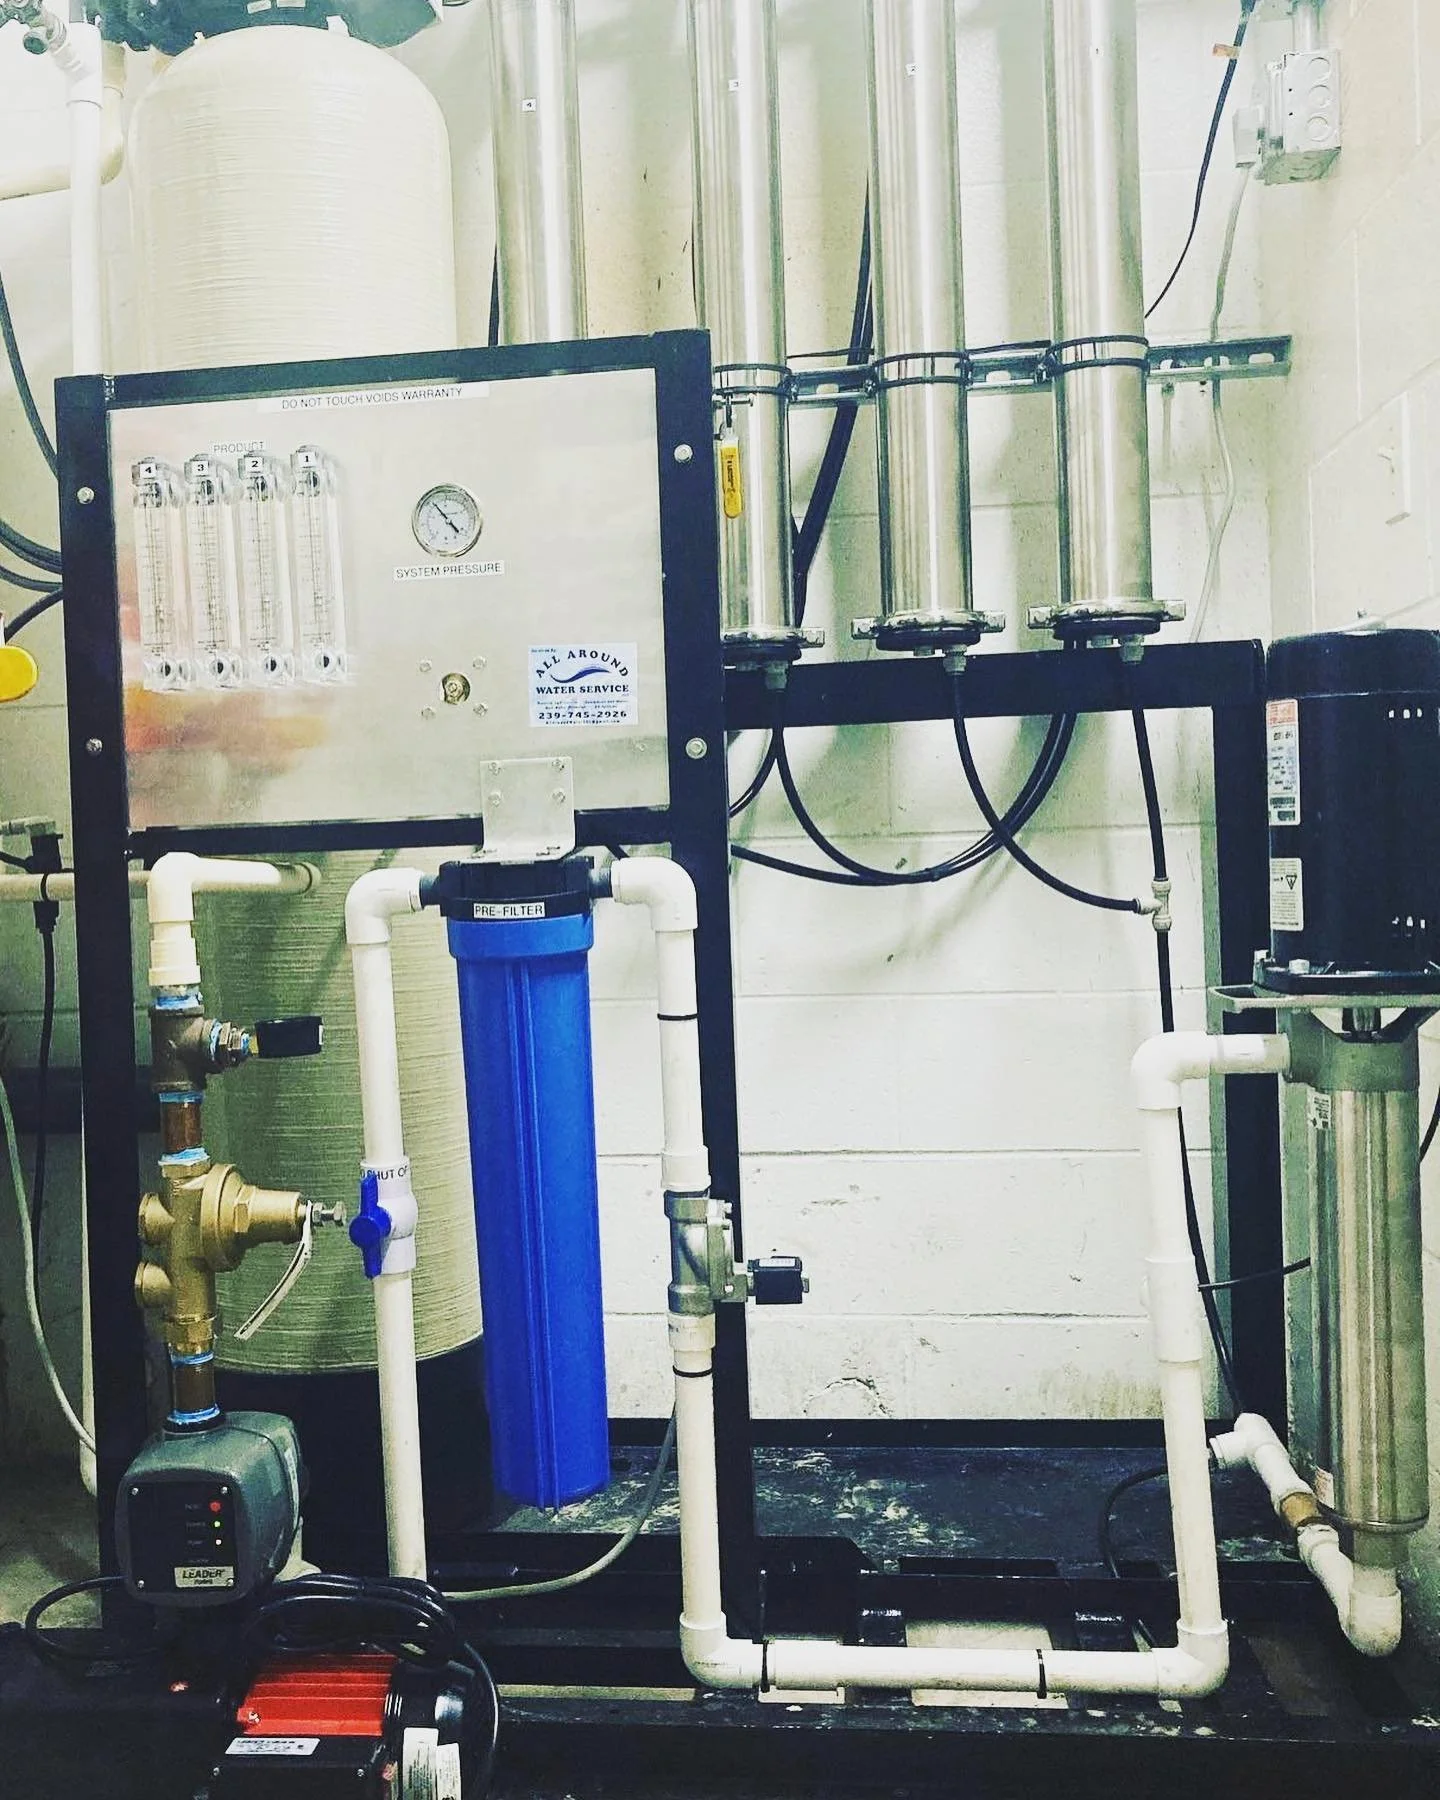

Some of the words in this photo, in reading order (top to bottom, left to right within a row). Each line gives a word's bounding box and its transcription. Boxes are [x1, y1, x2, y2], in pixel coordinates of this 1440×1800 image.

[281, 399, 298, 410] DO
[300, 397, 321, 408] NOT
[325, 395, 363, 407] TOUCH
[366, 392, 399, 404] VOIDS
[401, 387, 463, 401] WARRANTY
[213, 441, 264, 453] PRODUCT
[197, 464, 204, 472] 3
[251, 460, 259, 468] 2
[145, 466, 152, 474] 4
[396, 567, 440, 578] SYSTEM
[443, 562, 502, 576] PRESSURE
[536, 655, 561, 678] ALL
[567, 649, 629, 677] AROUND
[536, 686, 576, 695] WATER
[579, 684, 629, 694] SERVICE
[538, 710, 627, 720] 239-745-2926
[475, 905, 543, 917] PRE-FILTER
[182, 1569, 223, 1579] LEADER
